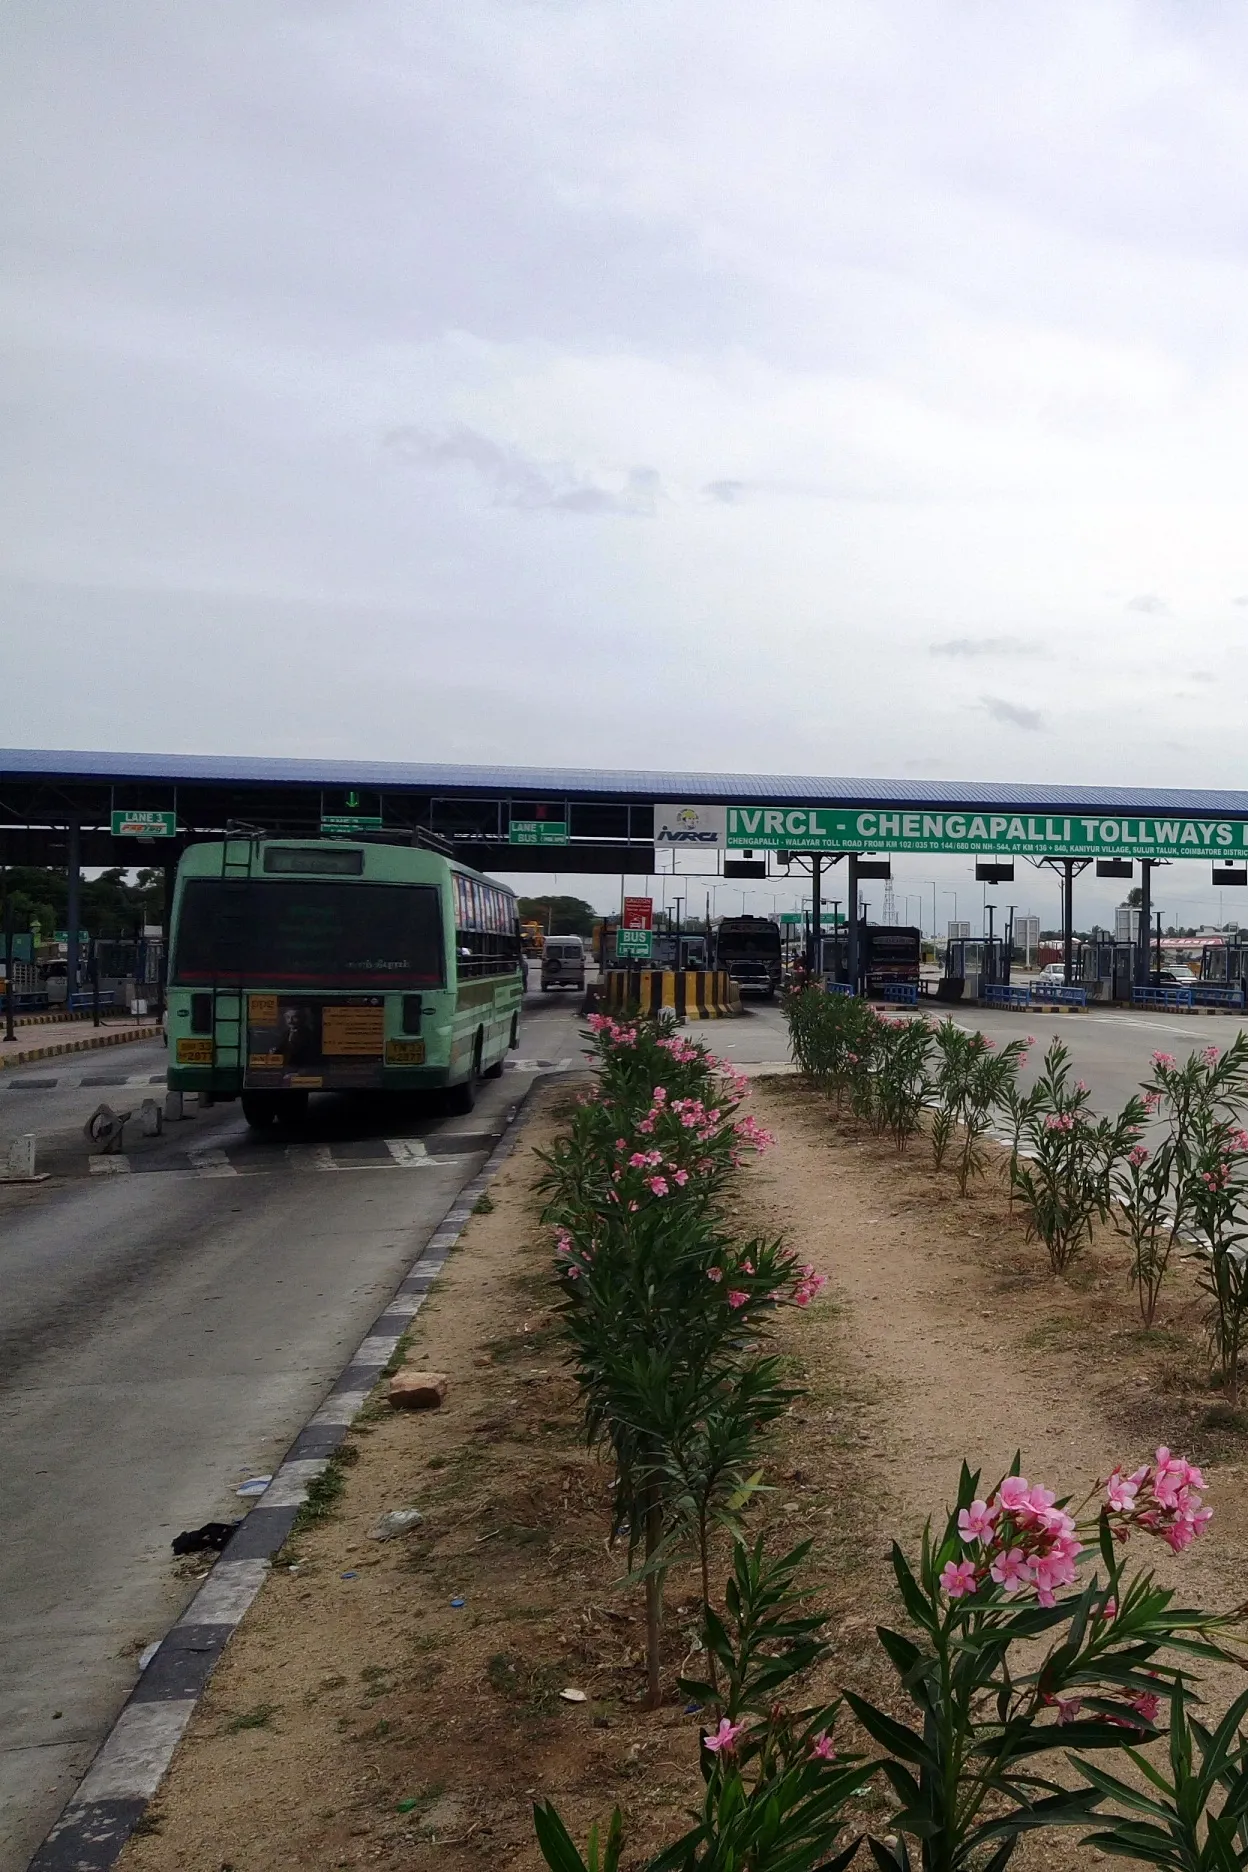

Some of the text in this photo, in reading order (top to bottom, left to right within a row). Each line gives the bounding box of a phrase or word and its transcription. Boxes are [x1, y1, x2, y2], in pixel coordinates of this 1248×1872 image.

[125, 813, 163, 822] LANE 3
[512, 823, 545, 833] LANE 1
[730, 809, 826, 835] IVRCL
[856, 813, 1070, 841] CHENGAPALLI
[1081, 819, 1233, 846] TOLLWAYS
[518, 834, 537, 843] BUS
[728, 837, 779, 846] CHENGAPALLI
[786, 838, 820, 846] WALAYAR
[822, 839, 840, 847] TOLL
[864, 840, 885, 848] FROM
[970, 842, 981, 850] ON
[1012, 843, 1021, 851] AT
[1070, 845, 1100, 853] KANIYUR
[1101, 846, 1131, 854] VILLAGE,
[1133, 846, 1155, 854] SULUR
[1156, 847, 1179, 856] TALUK,
[1180, 848, 1221, 856] COIMBATORE
[623, 931, 646, 943] BUS
